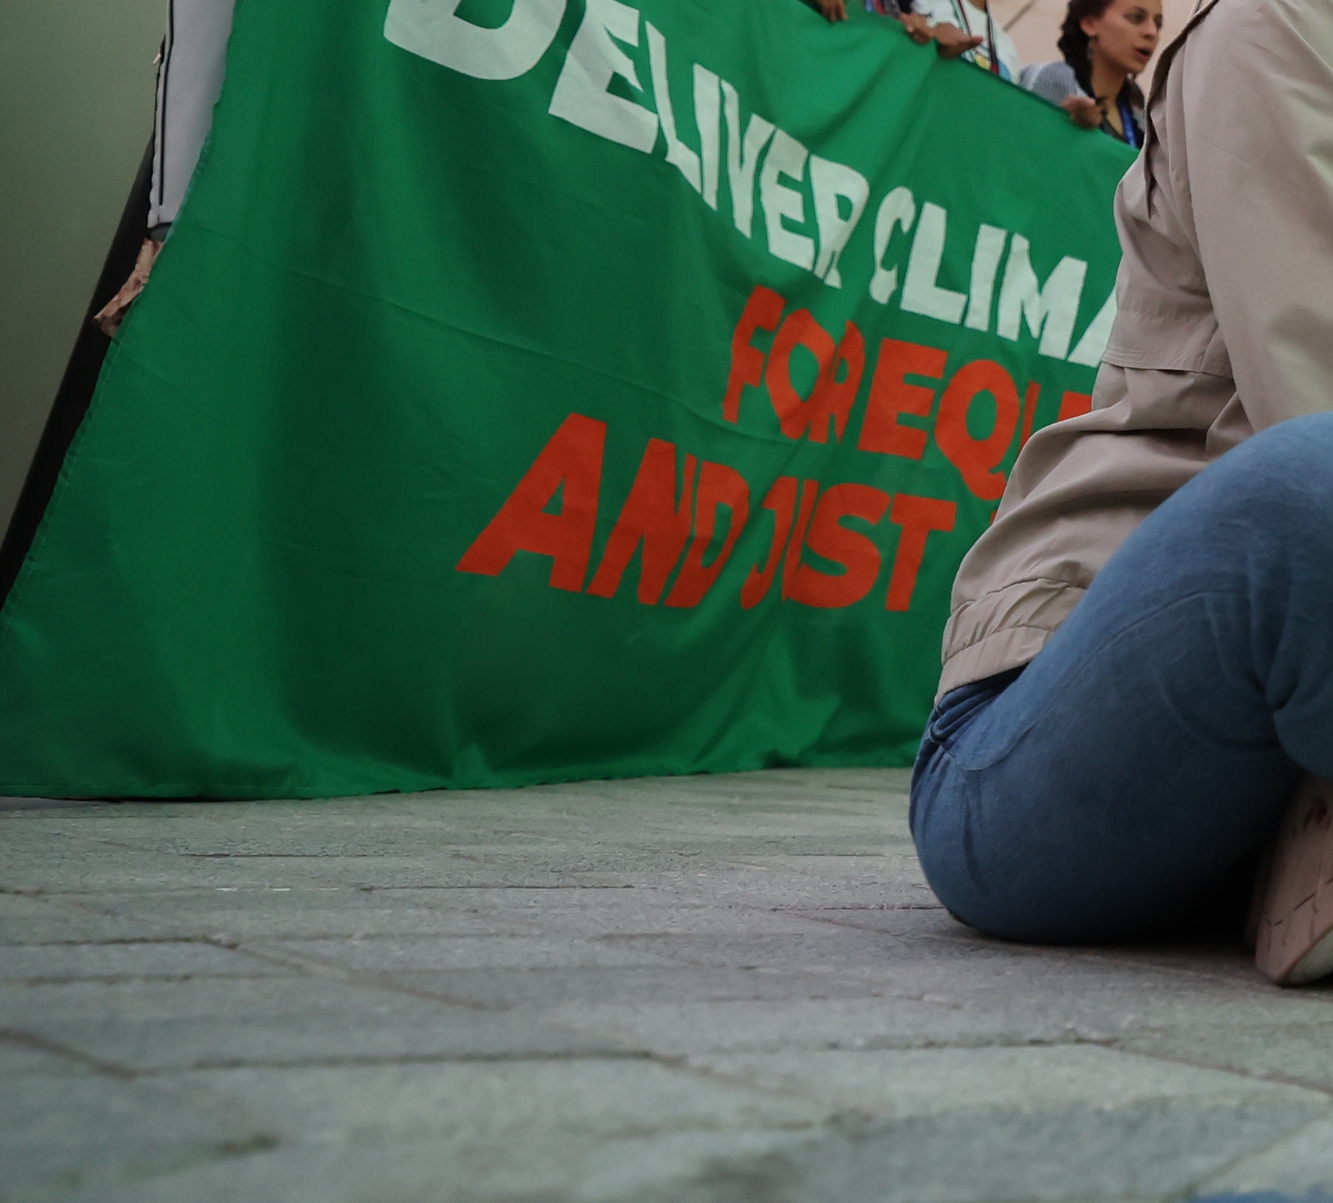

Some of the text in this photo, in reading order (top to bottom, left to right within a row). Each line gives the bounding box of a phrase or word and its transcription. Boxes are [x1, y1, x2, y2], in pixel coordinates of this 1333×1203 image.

[722, 286, 866, 445] FOR
[455, 413, 956, 612] AND JUST
